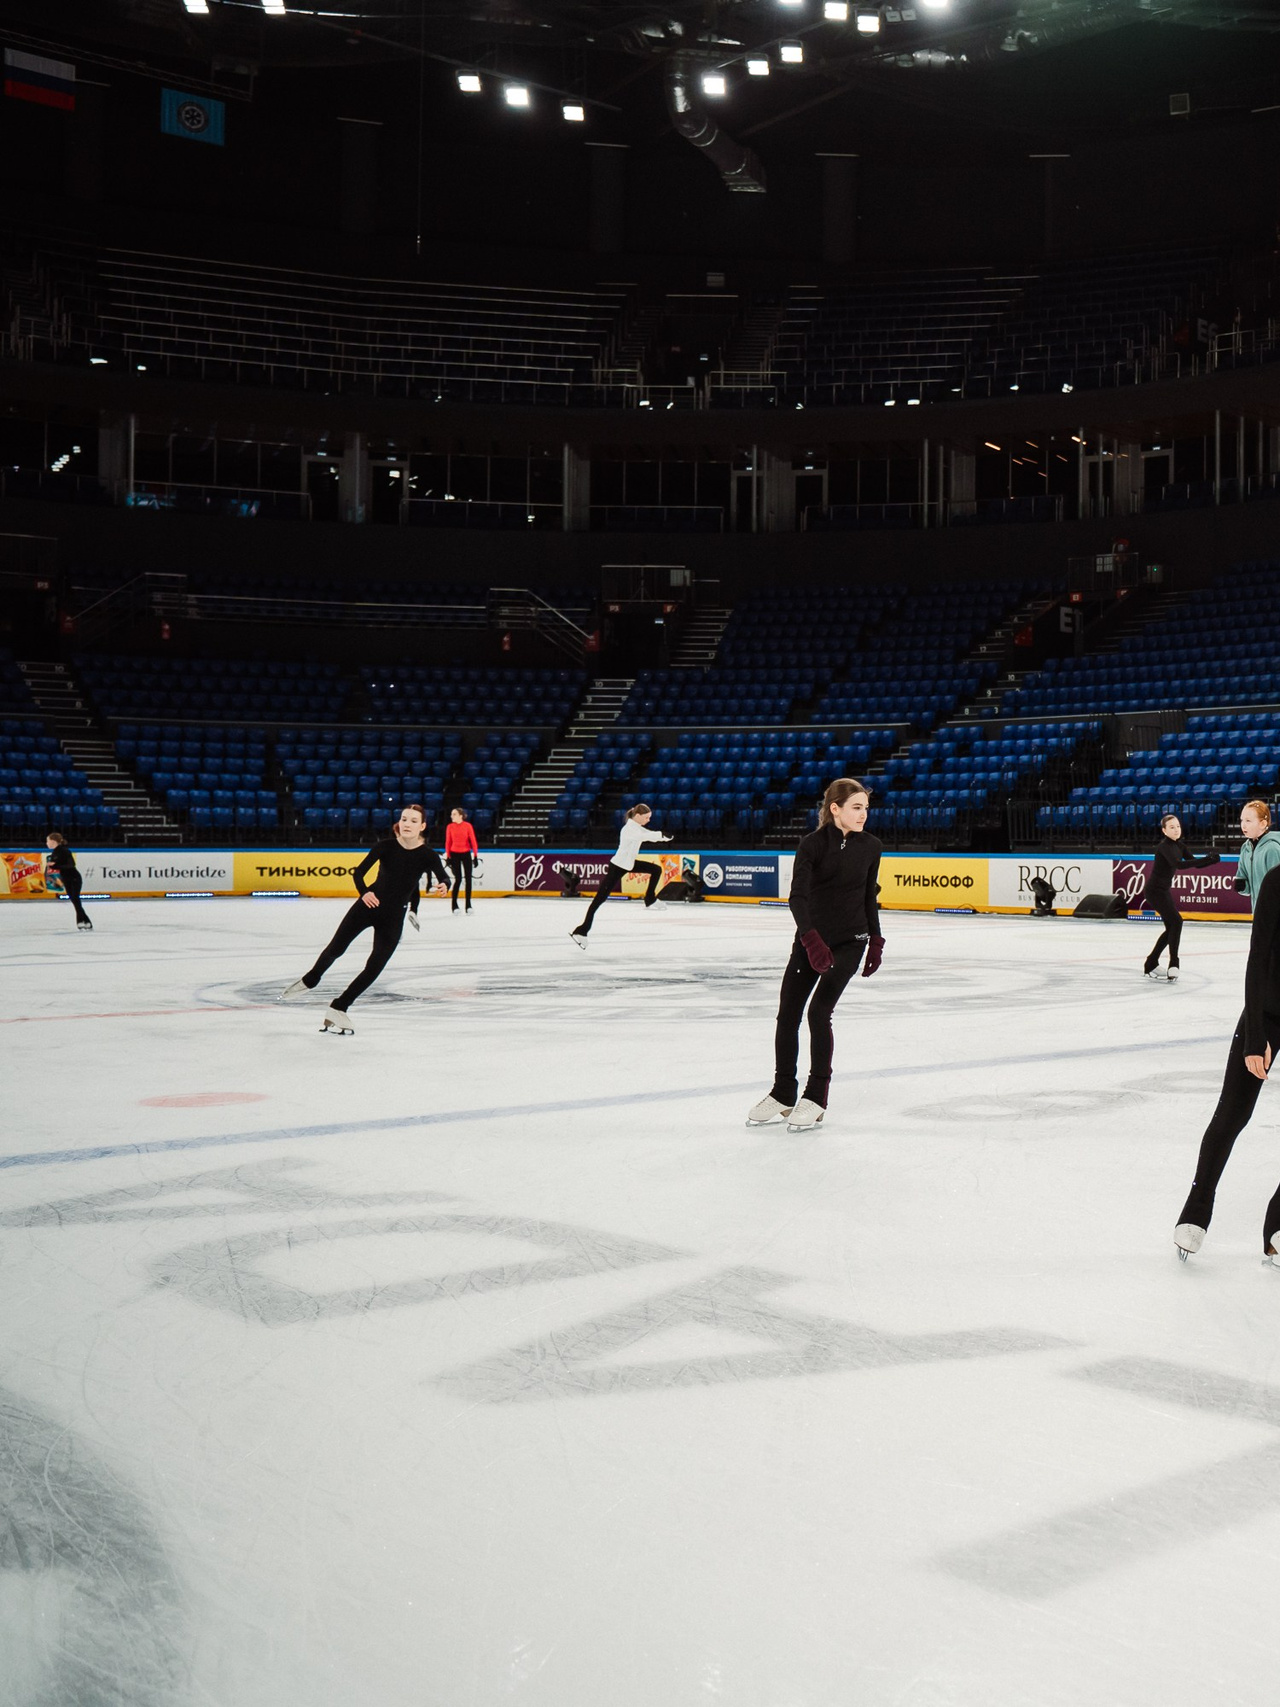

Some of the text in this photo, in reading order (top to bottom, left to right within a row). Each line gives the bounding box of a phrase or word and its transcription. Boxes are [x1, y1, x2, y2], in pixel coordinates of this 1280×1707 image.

[101, 866, 142, 879] Team
[145, 866, 227, 879] Tutberidze
[551, 860, 609, 879] Фигурис
[894, 874, 975, 890] ТИНЬКОФФ
[1171, 874, 1236, 894] игурис
[1179, 895, 1219, 904] магазин
